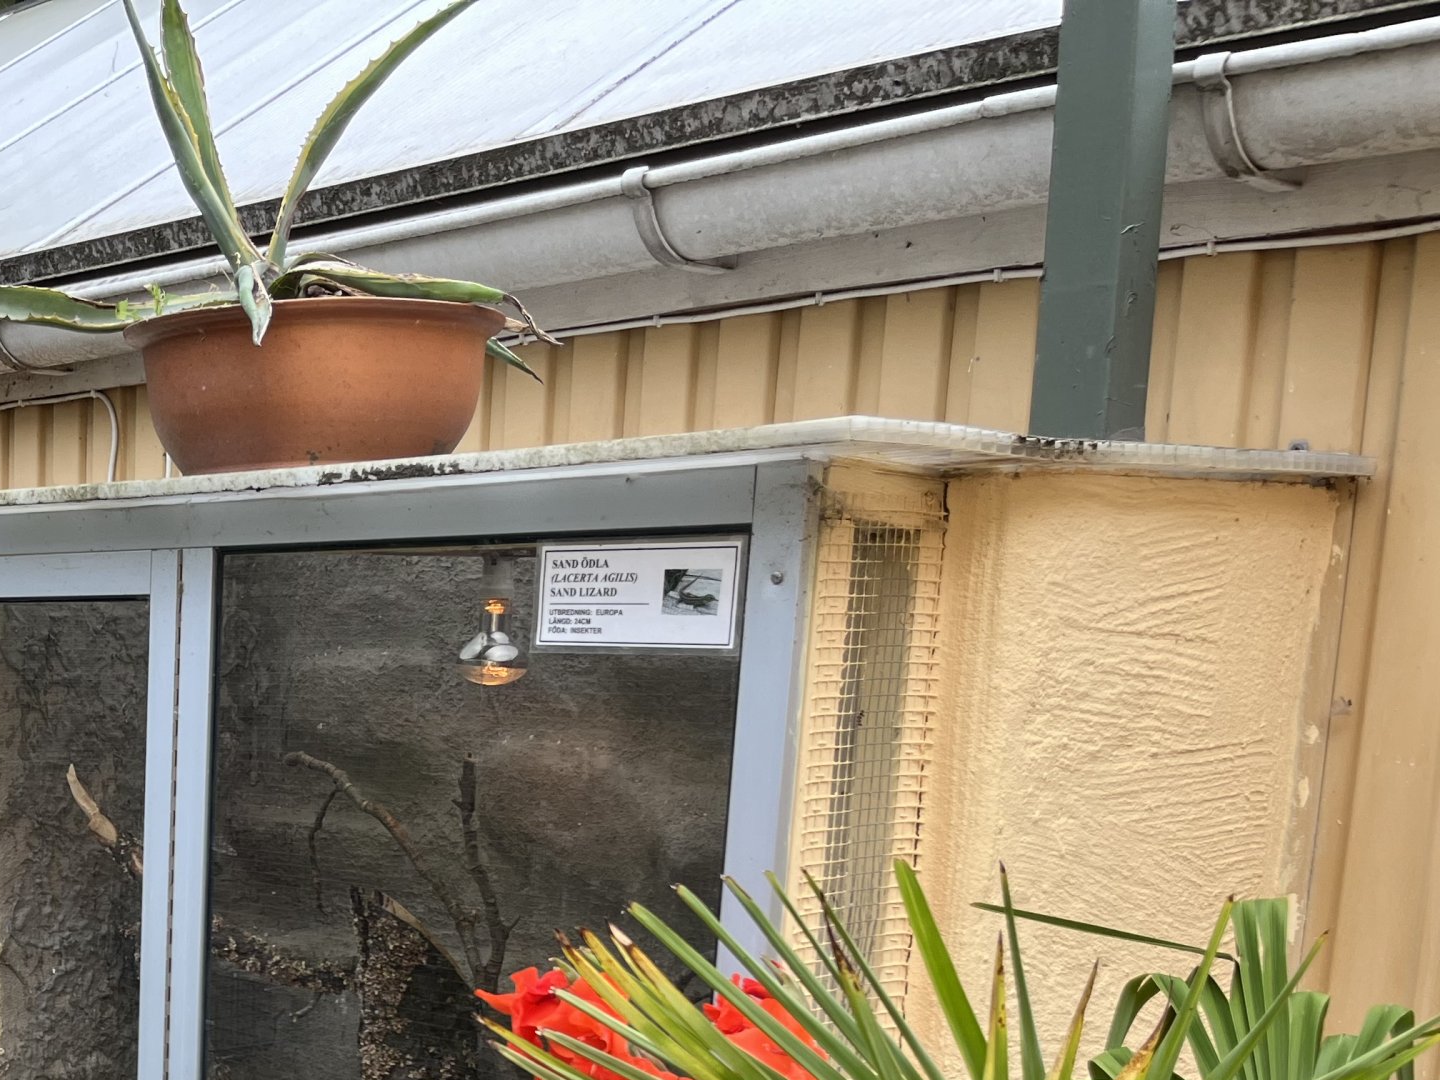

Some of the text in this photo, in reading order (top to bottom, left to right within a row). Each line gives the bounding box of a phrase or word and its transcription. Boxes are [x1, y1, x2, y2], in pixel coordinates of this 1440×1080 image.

[552, 557, 609, 568] SAND ÖDLA
[551, 573, 638, 584] (LACERTA AGILIS)
[550, 588, 617, 597] SAND LIZARD
[548, 617, 572, 625] LÄNGD:
[548, 626, 567, 634] FÖDA:
